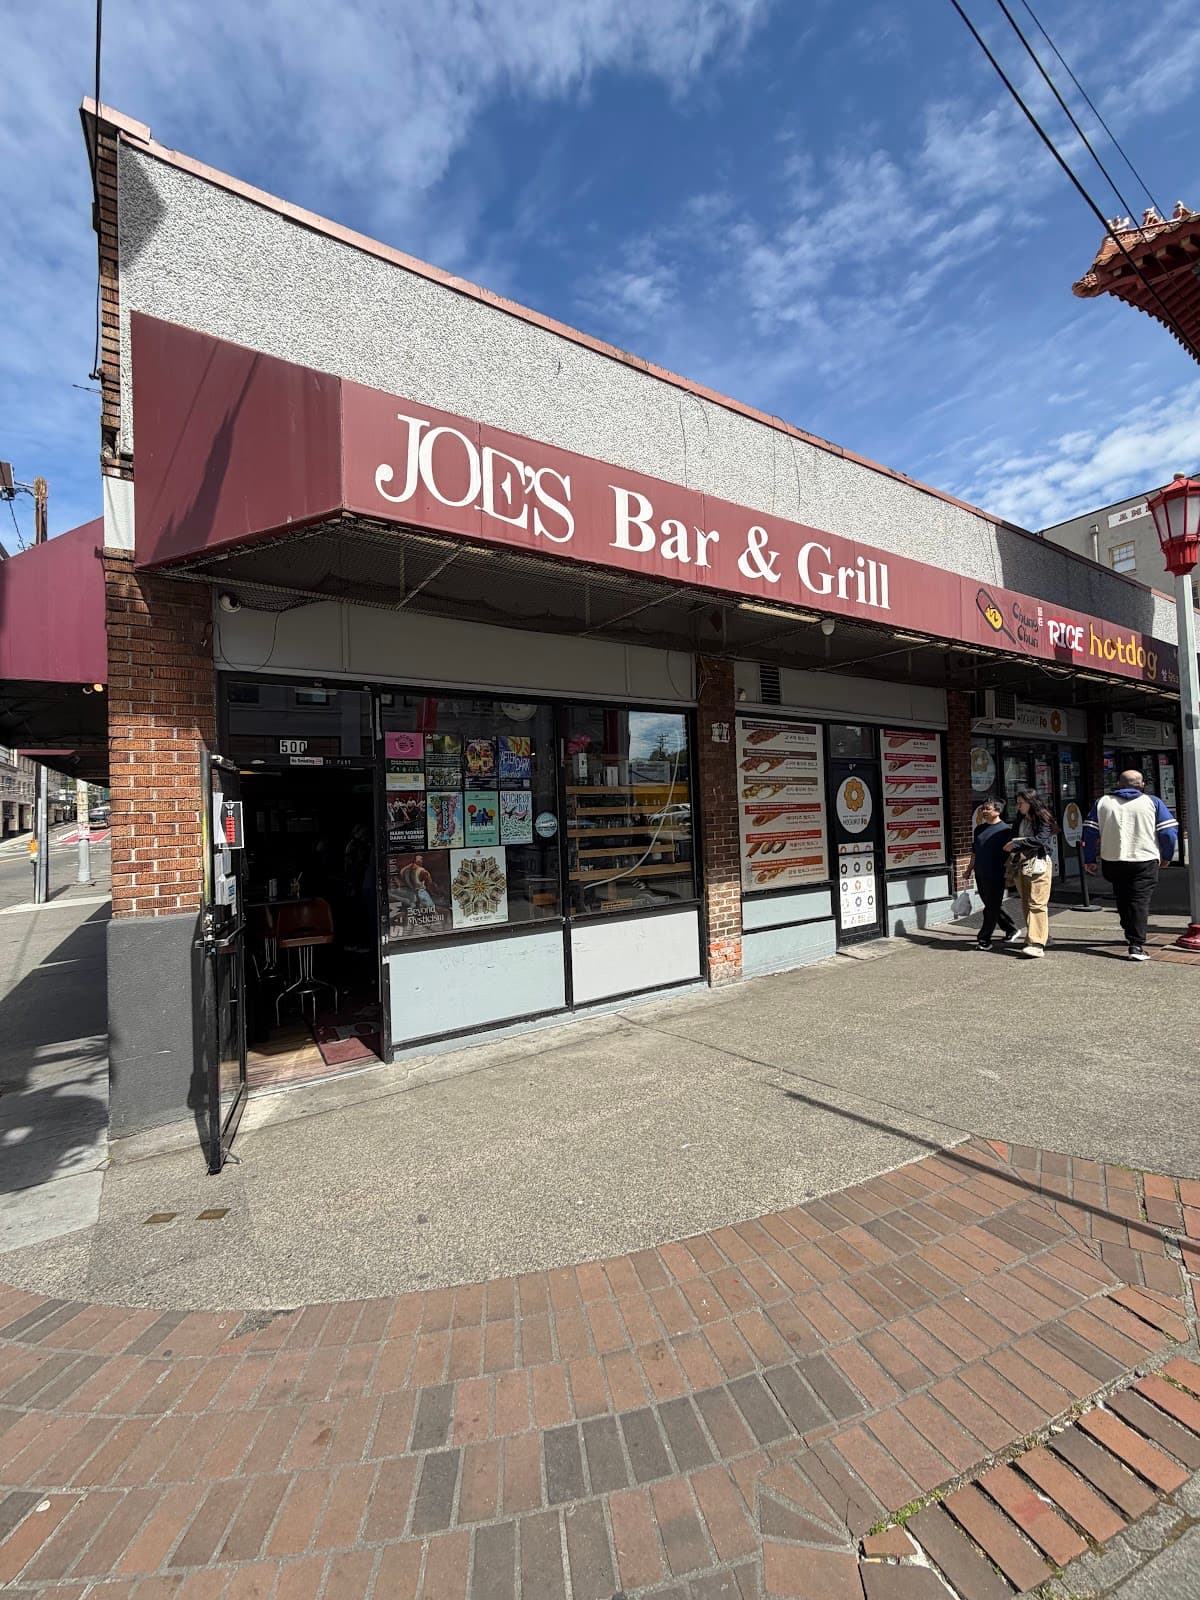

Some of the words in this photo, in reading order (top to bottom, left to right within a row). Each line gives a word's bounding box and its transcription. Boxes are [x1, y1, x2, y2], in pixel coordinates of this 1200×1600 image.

[375, 413, 575, 544] JOE'S
[608, 485, 720, 569] Bar
[737, 525, 782, 584] &
[797, 541, 892, 610] Grill
[1047, 619, 1084, 652] RICE
[1089, 623, 1158, 680] hotdog
[281, 741, 306, 753] 500
[407, 904, 436, 917] Beyond
[407, 914, 444, 924] Mysticism
